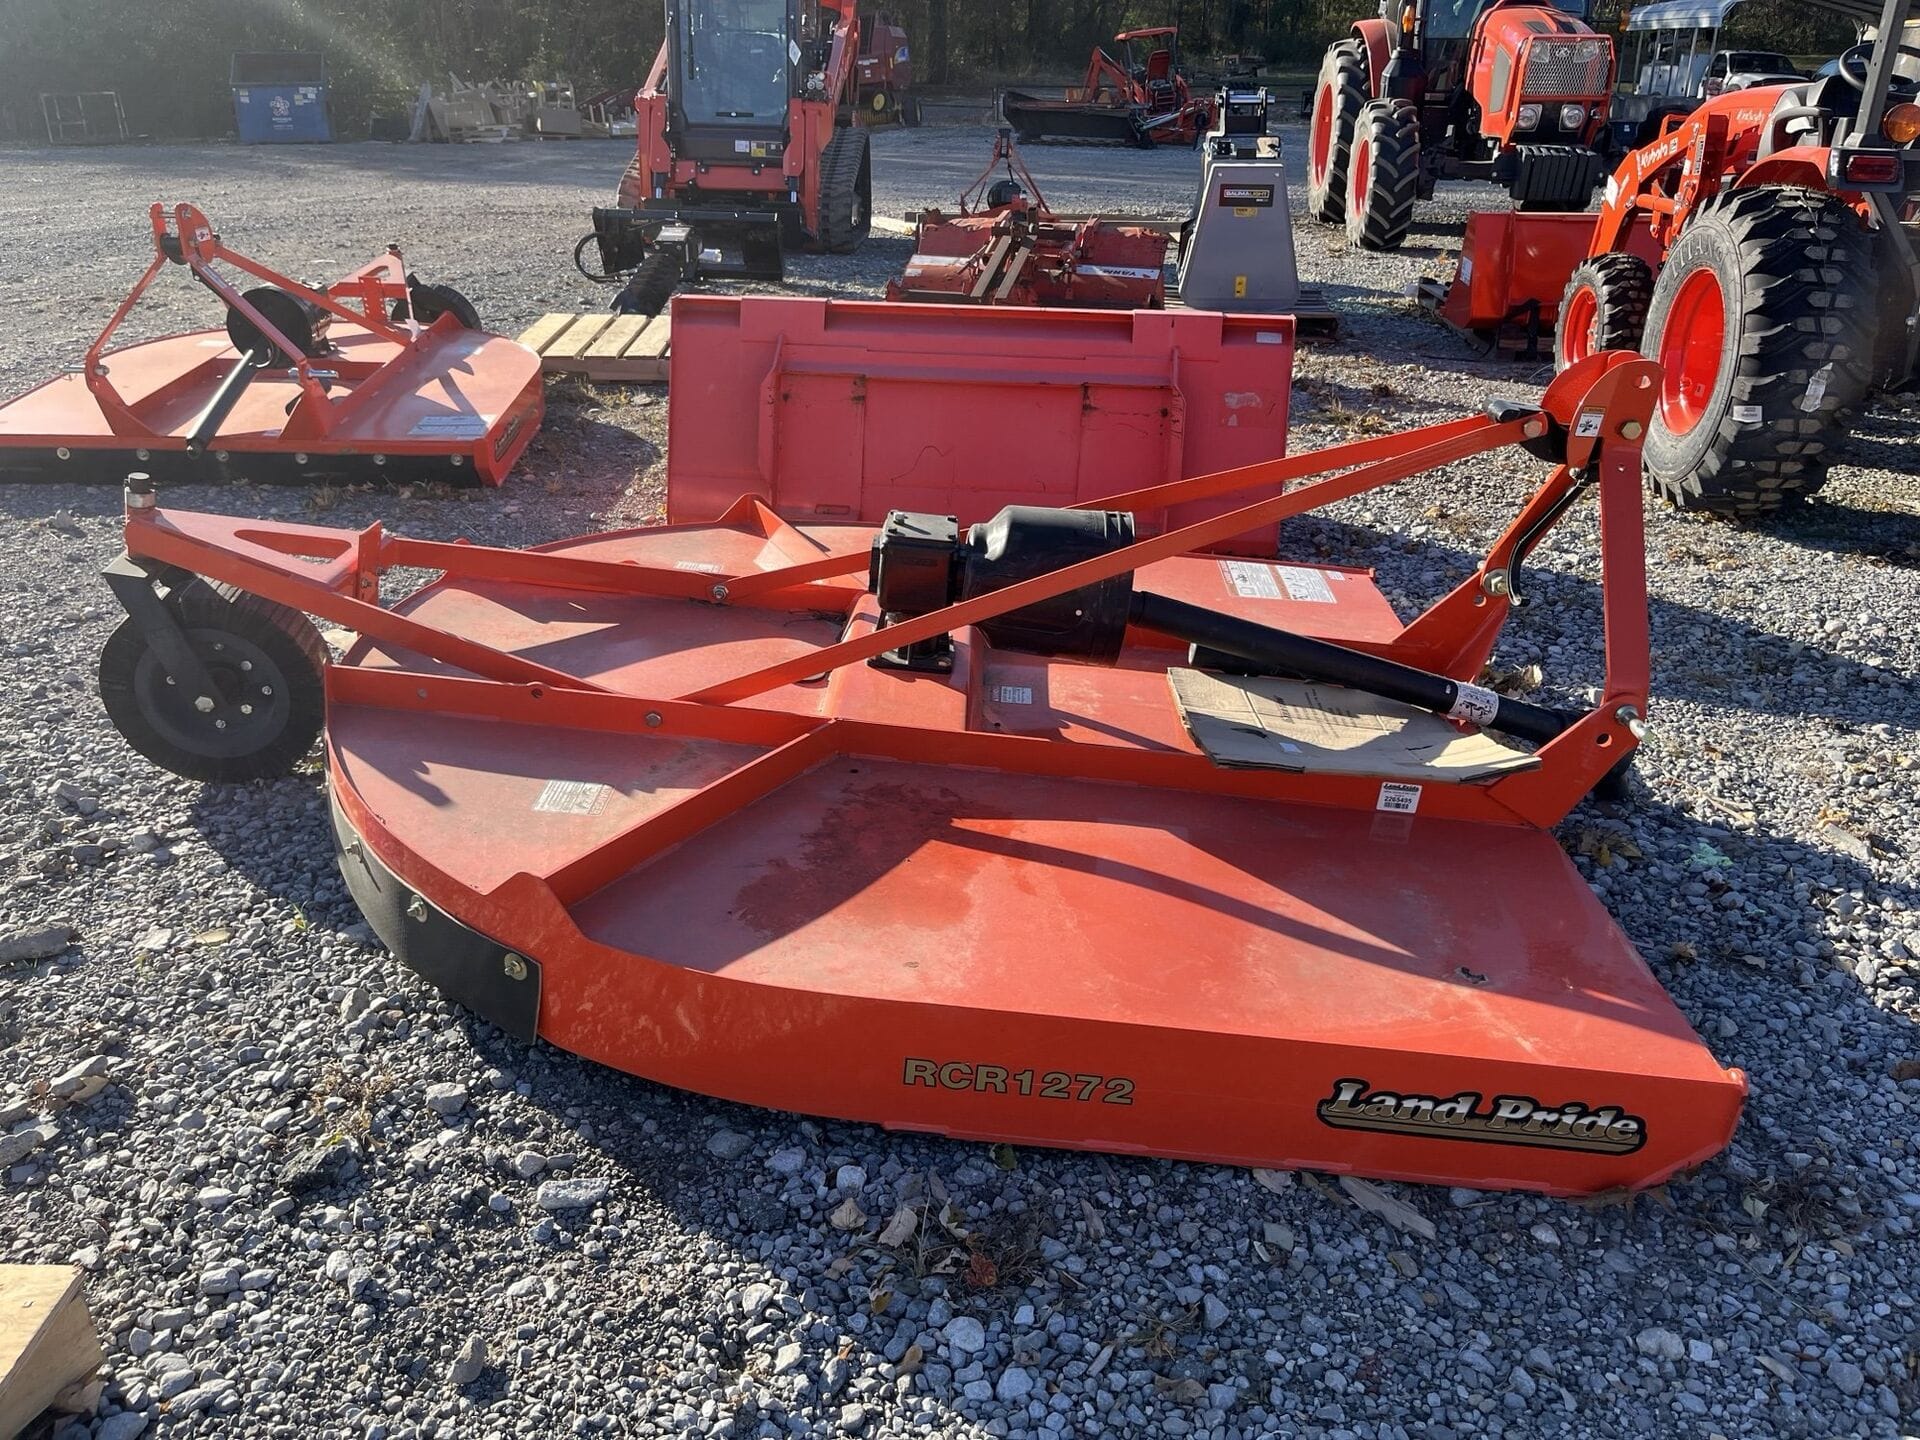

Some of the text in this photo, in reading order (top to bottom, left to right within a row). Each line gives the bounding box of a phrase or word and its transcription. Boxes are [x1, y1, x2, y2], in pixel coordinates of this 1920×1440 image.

[903, 1058, 1136, 1105] RCR1272
[1327, 1082, 1639, 1142] Land Pride
